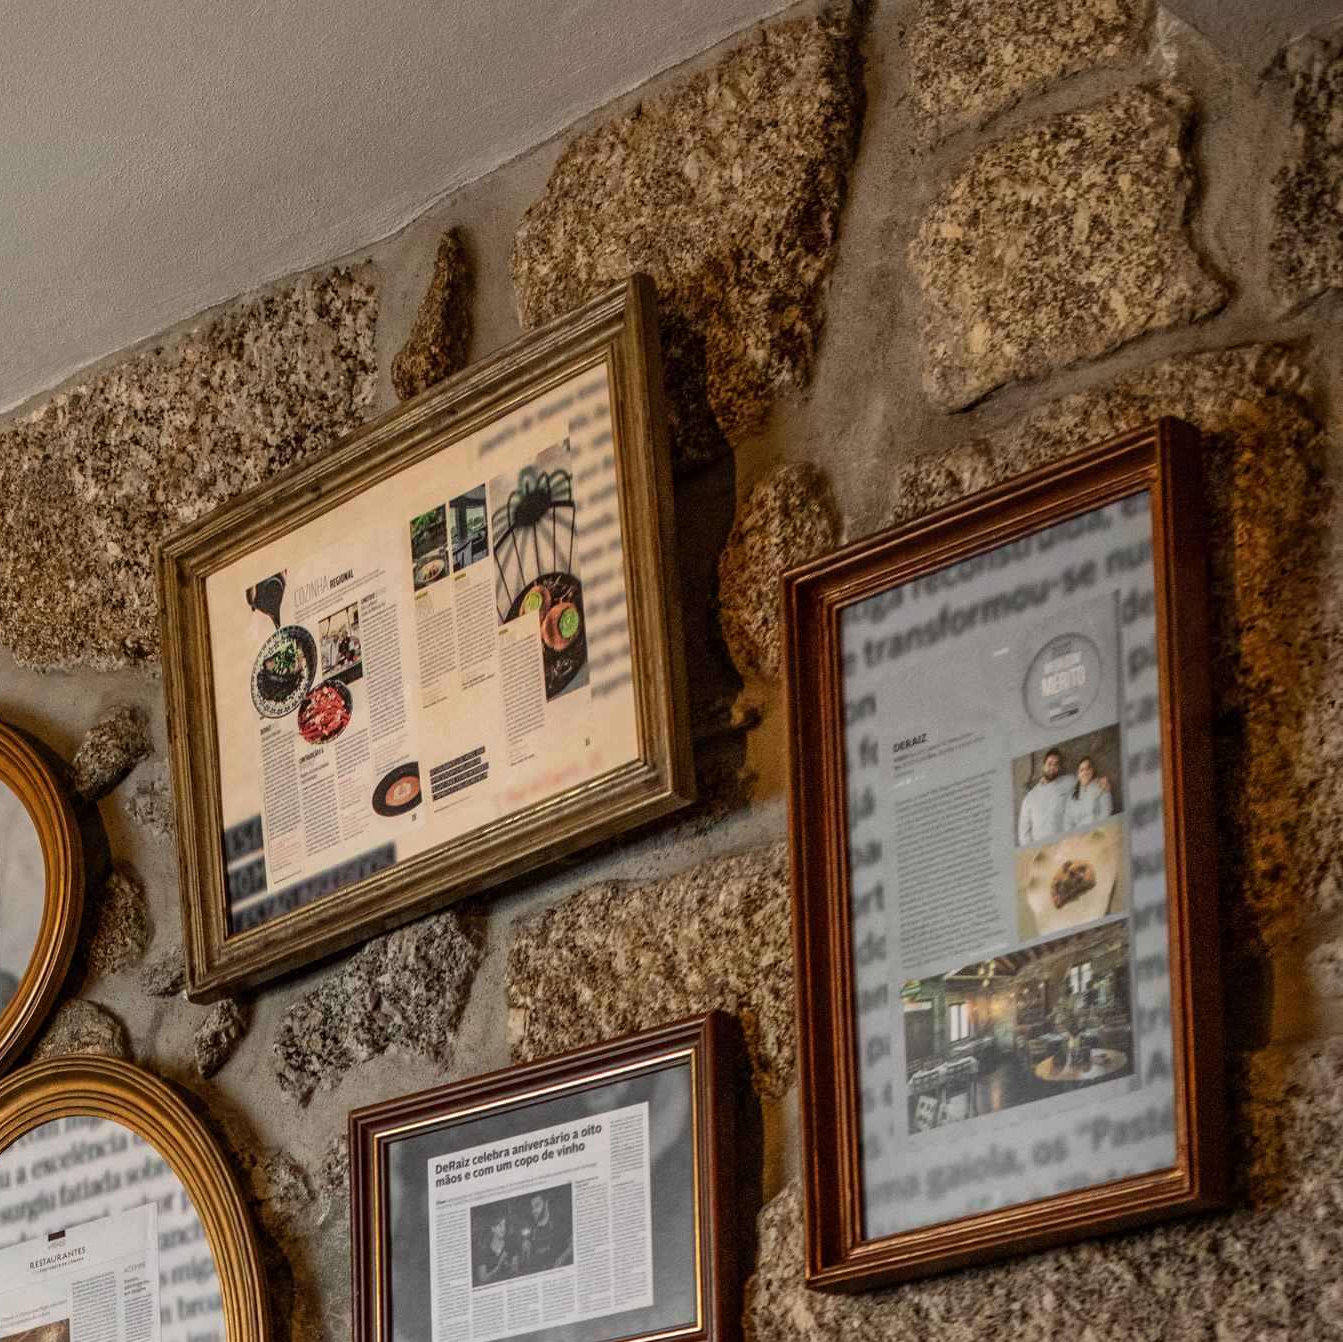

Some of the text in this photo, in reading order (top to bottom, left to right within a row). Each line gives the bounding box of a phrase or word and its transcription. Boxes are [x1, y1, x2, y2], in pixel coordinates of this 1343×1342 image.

[435, 1123, 603, 1176] DeRaiz celebra aniversário a oito
[435, 1141, 586, 1189] mãos e com um copo de vinho
[29, 1246, 87, 1270] RESTAURANTES
